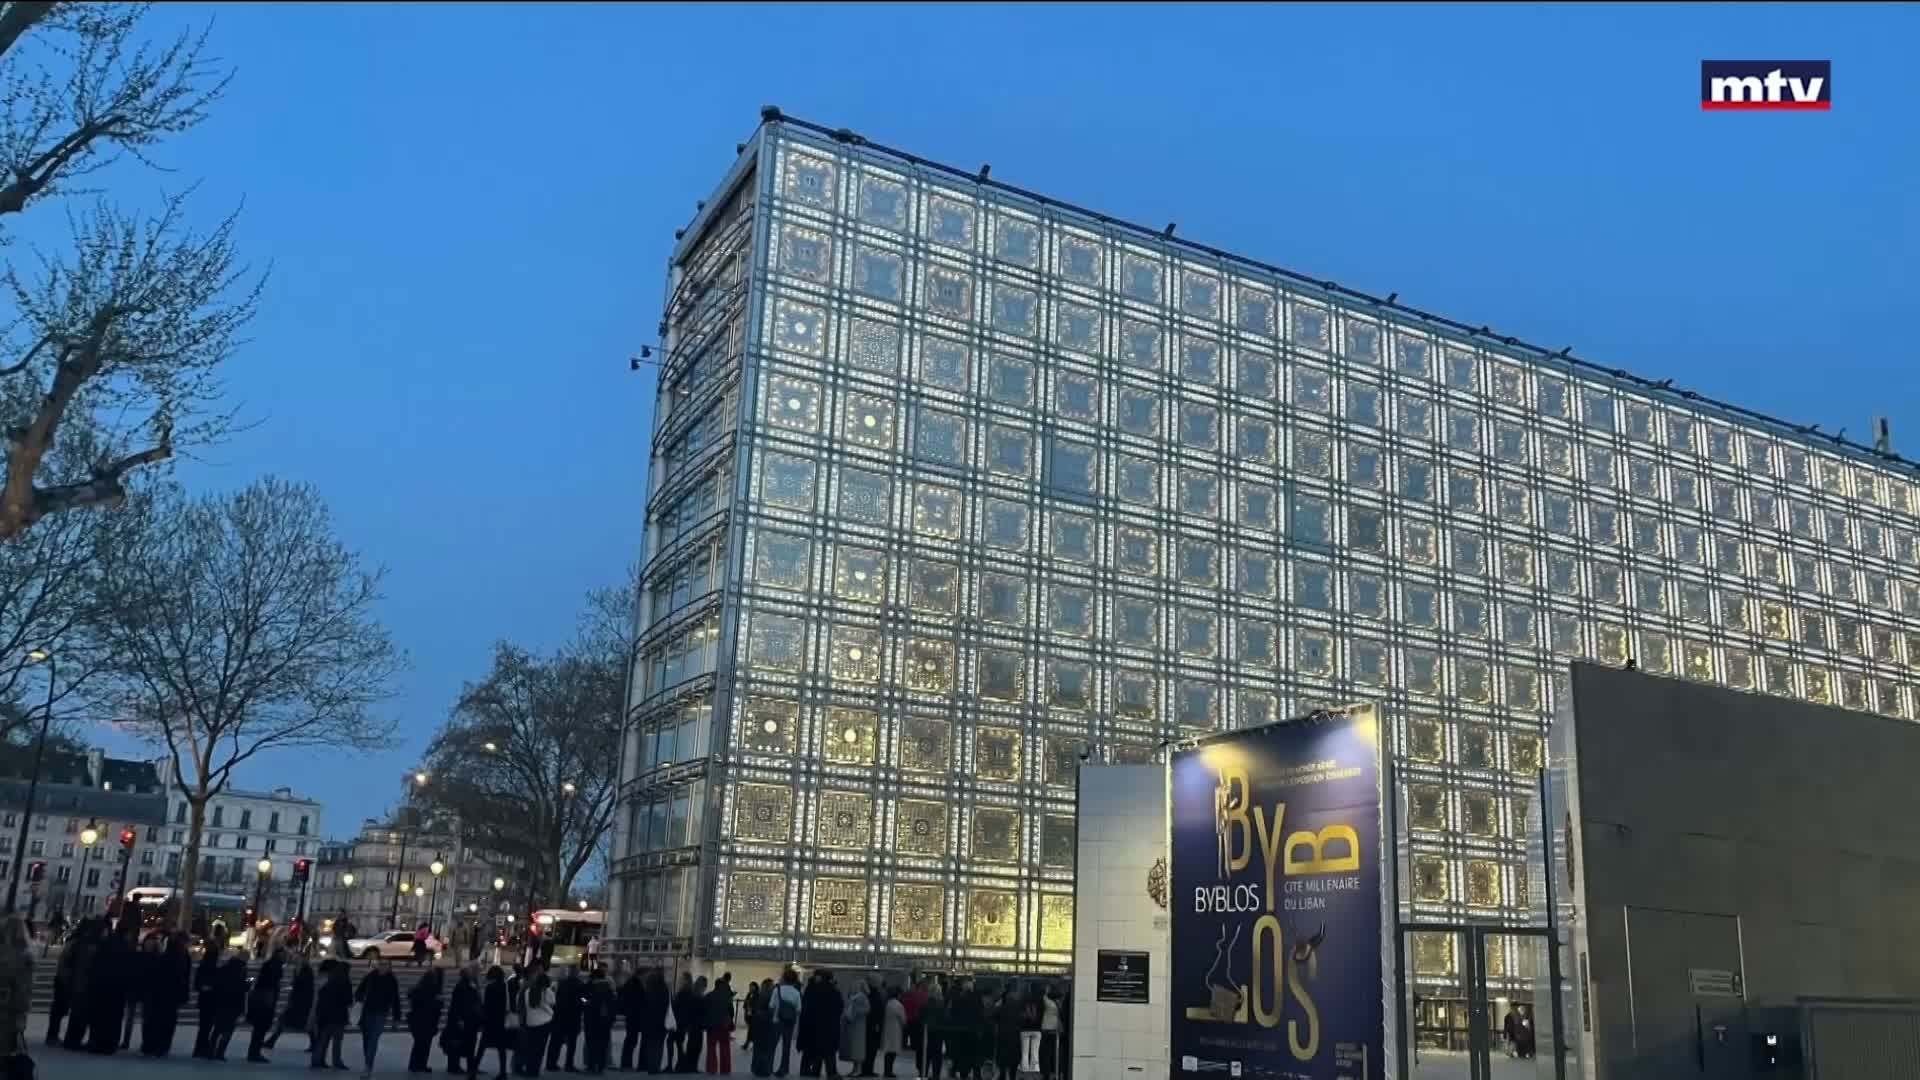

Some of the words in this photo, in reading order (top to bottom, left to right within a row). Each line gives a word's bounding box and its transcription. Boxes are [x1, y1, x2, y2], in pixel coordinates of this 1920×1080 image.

[1195, 884, 1260, 912] BYBLOS
[1283, 898, 1297, 911] DU
[1298, 897, 1326, 910] LIBAN
